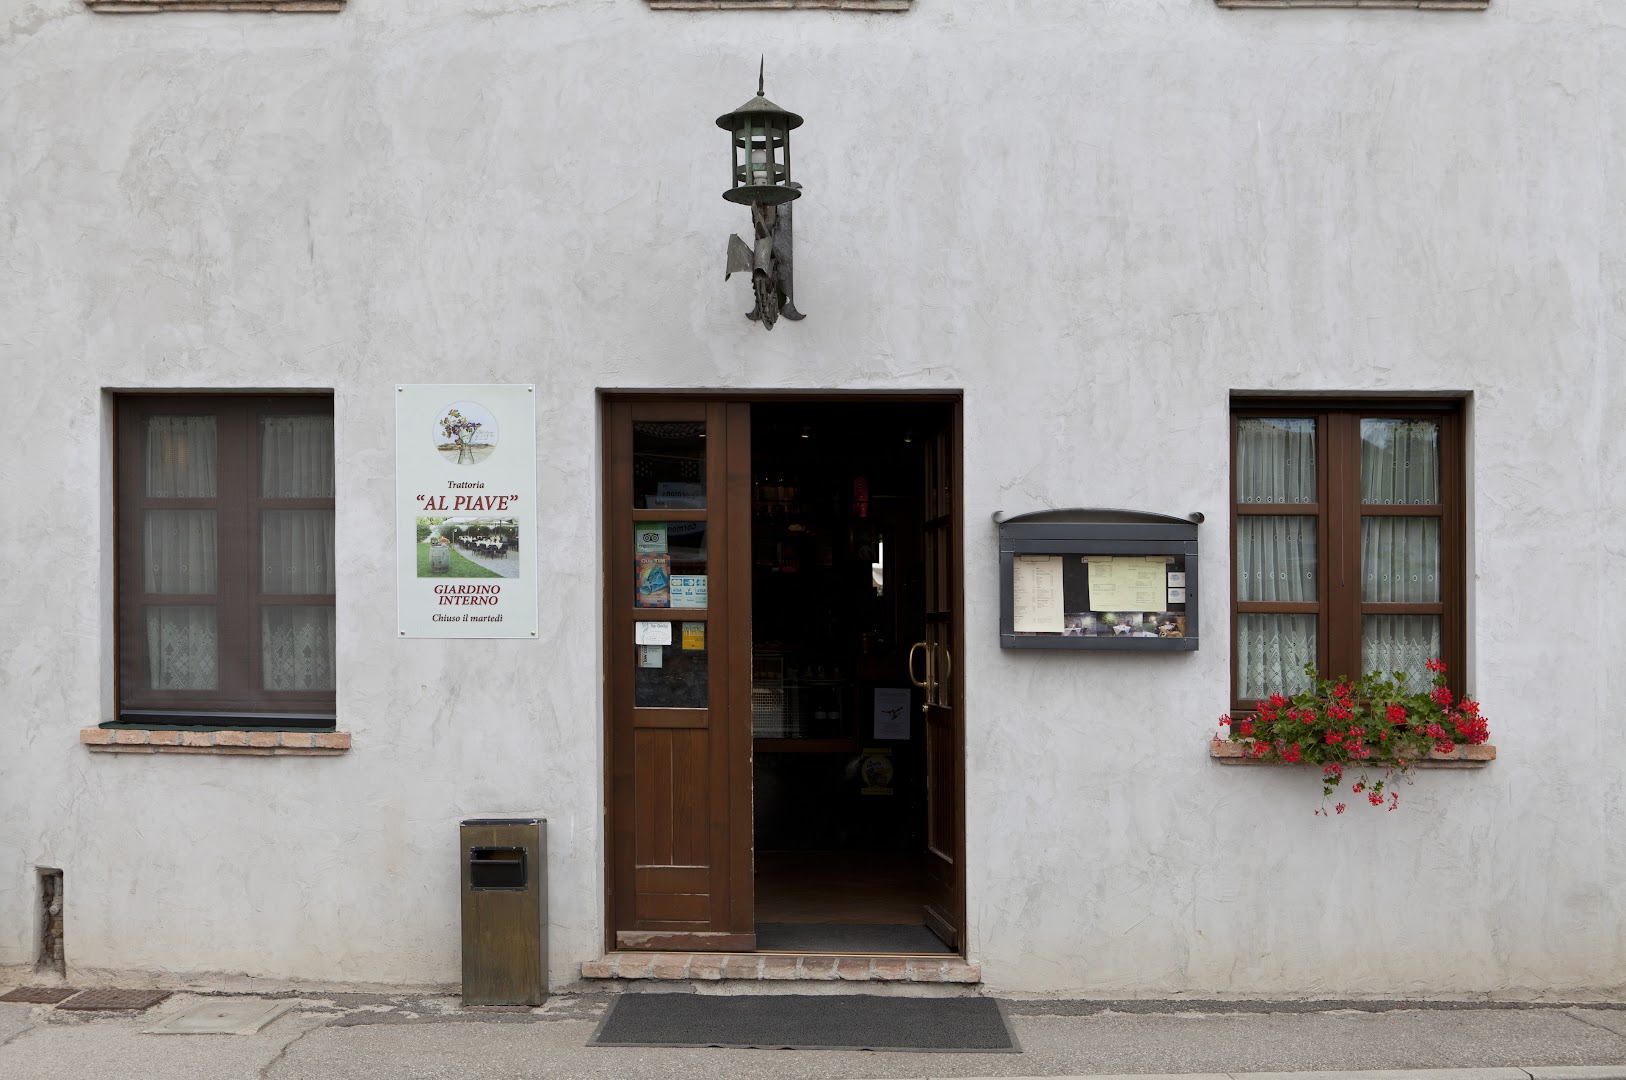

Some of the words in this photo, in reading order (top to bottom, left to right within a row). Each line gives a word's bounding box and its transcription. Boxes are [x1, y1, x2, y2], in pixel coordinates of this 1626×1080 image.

[447, 480, 485, 489] Trattoria
[416, 494, 448, 511] “AL
[453, 494, 518, 511] PIAVE”
[434, 584, 501, 595] GIARDINO
[438, 595, 499, 606] INTERNO
[432, 614, 460, 622] Chiuso
[462, 614, 469, 622] il
